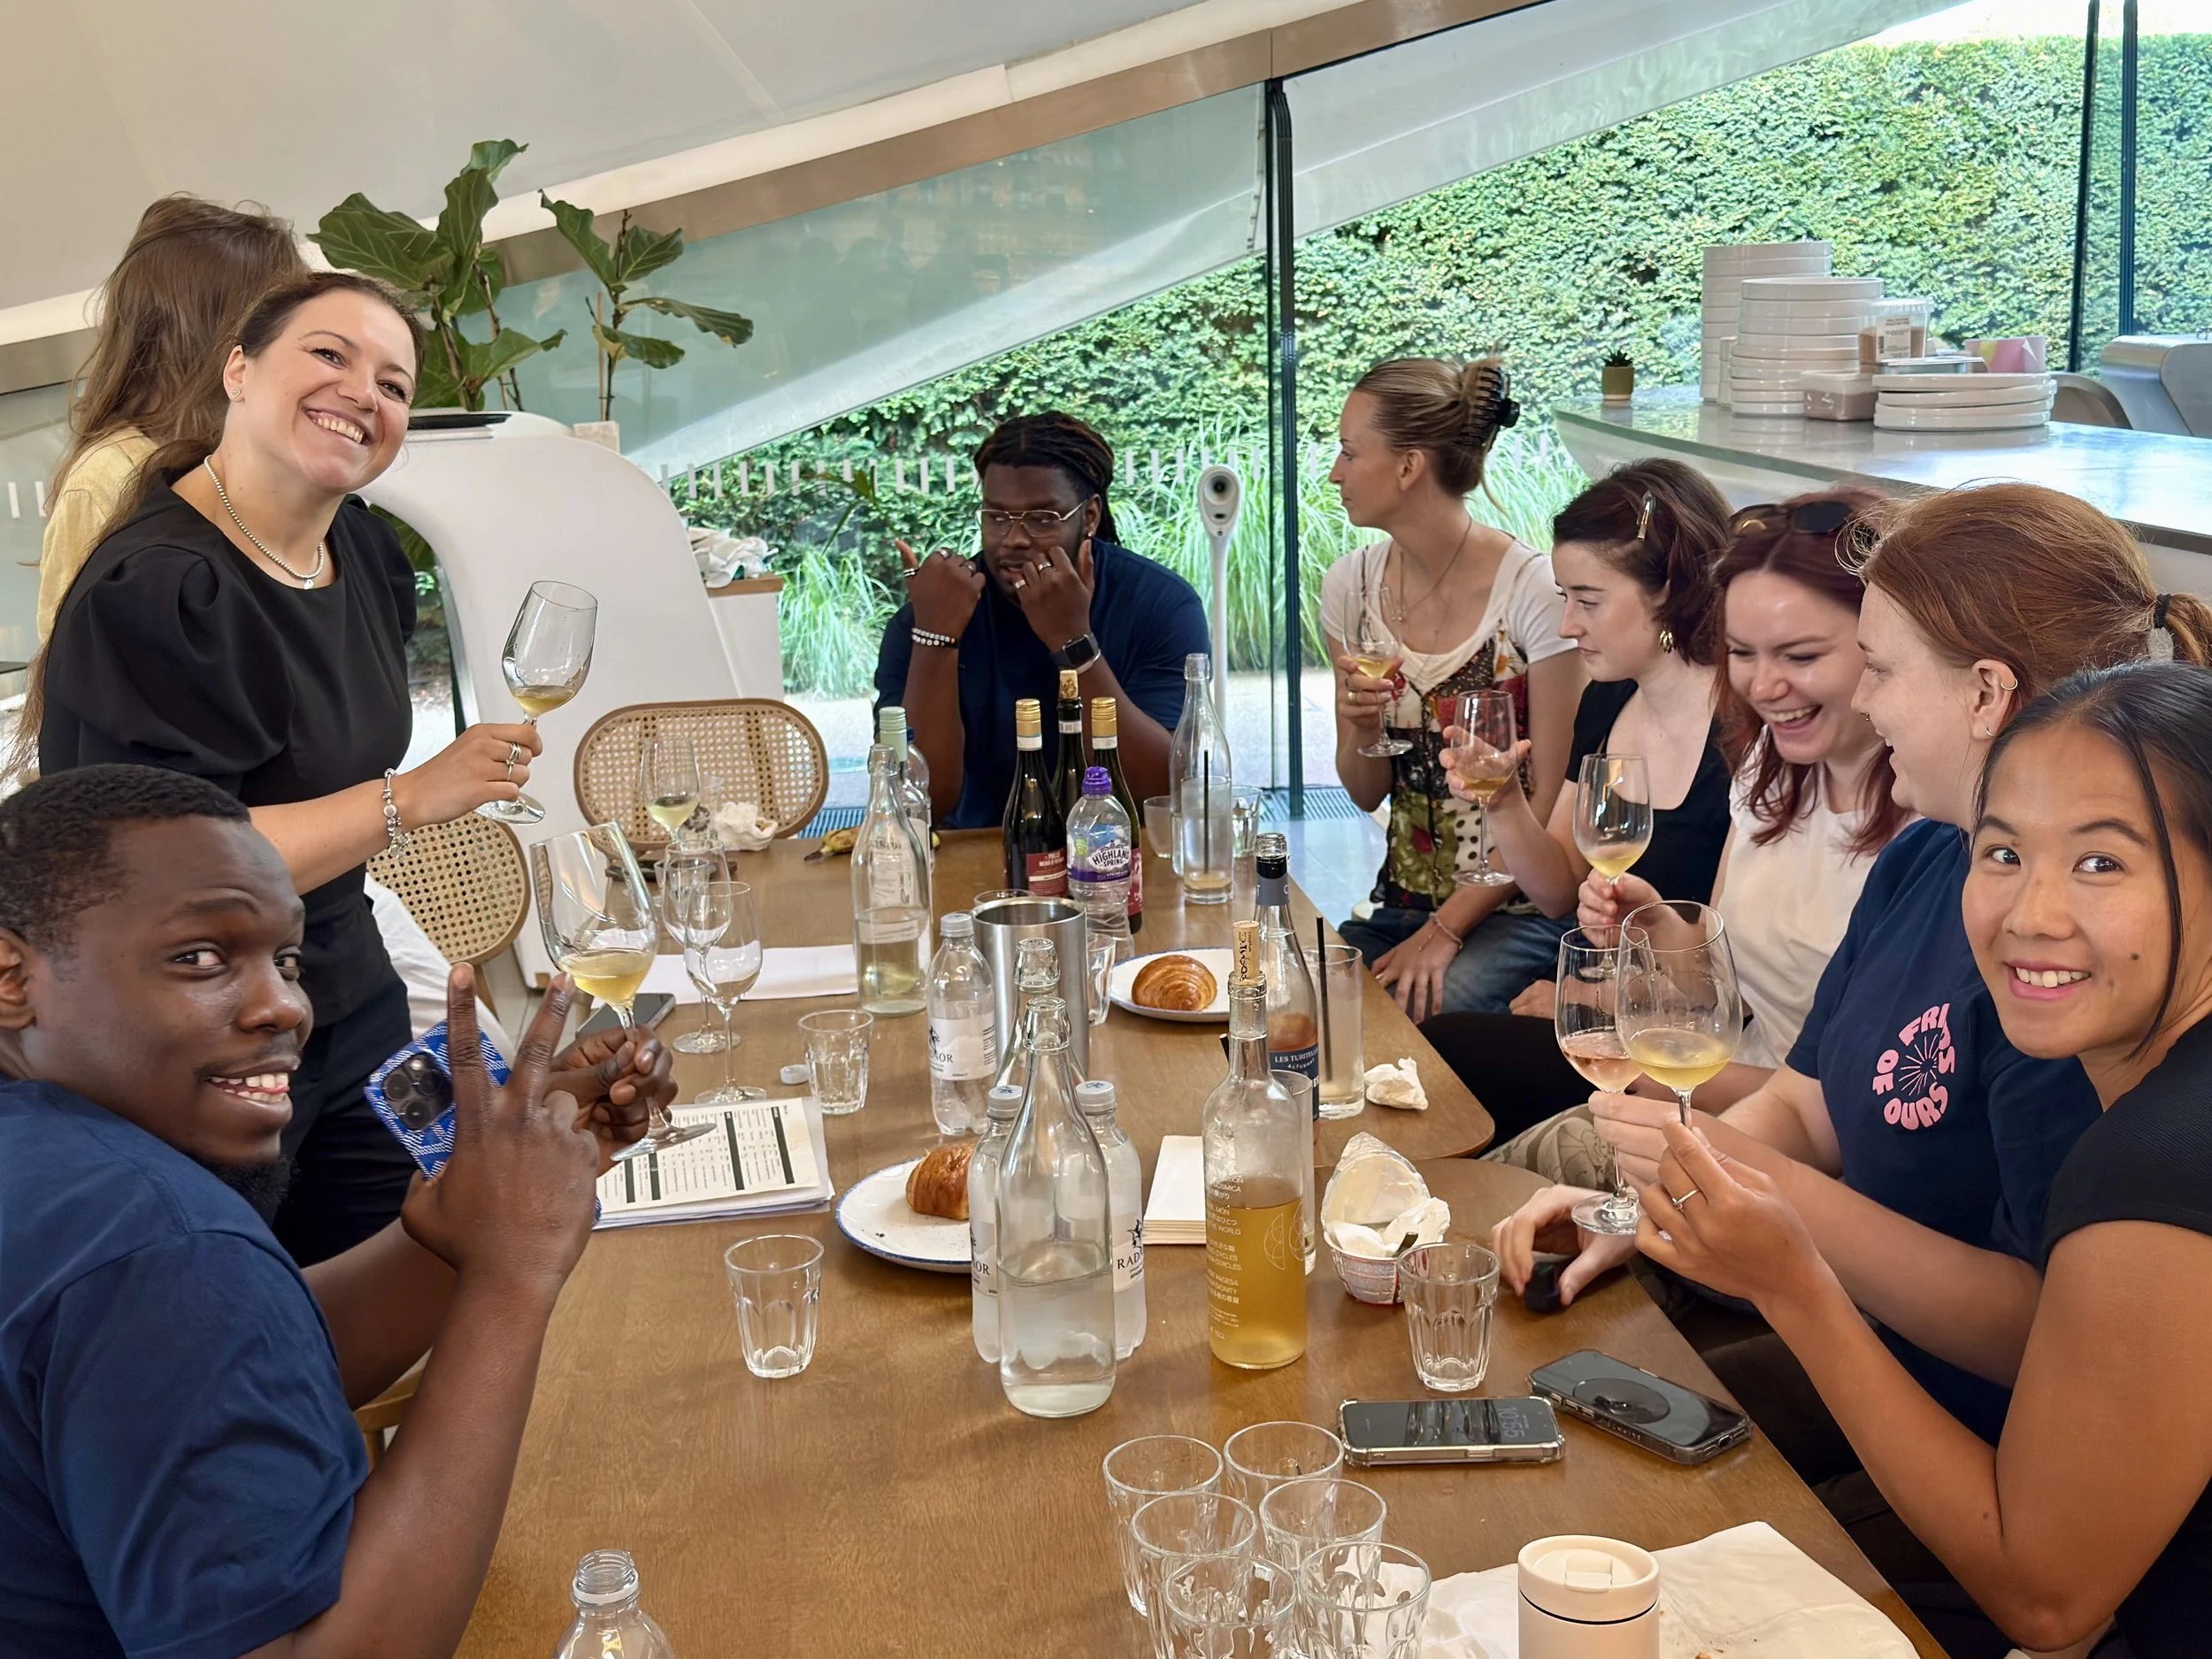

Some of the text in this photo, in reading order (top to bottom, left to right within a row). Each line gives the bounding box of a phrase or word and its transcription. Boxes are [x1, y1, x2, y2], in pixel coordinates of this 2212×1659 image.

[1092, 849, 1130, 865] HIGHLAND
[1102, 858, 1123, 867] SPRING
[1872, 1049, 1900, 1095] OF
[1883, 1081, 1948, 1131] OURS
